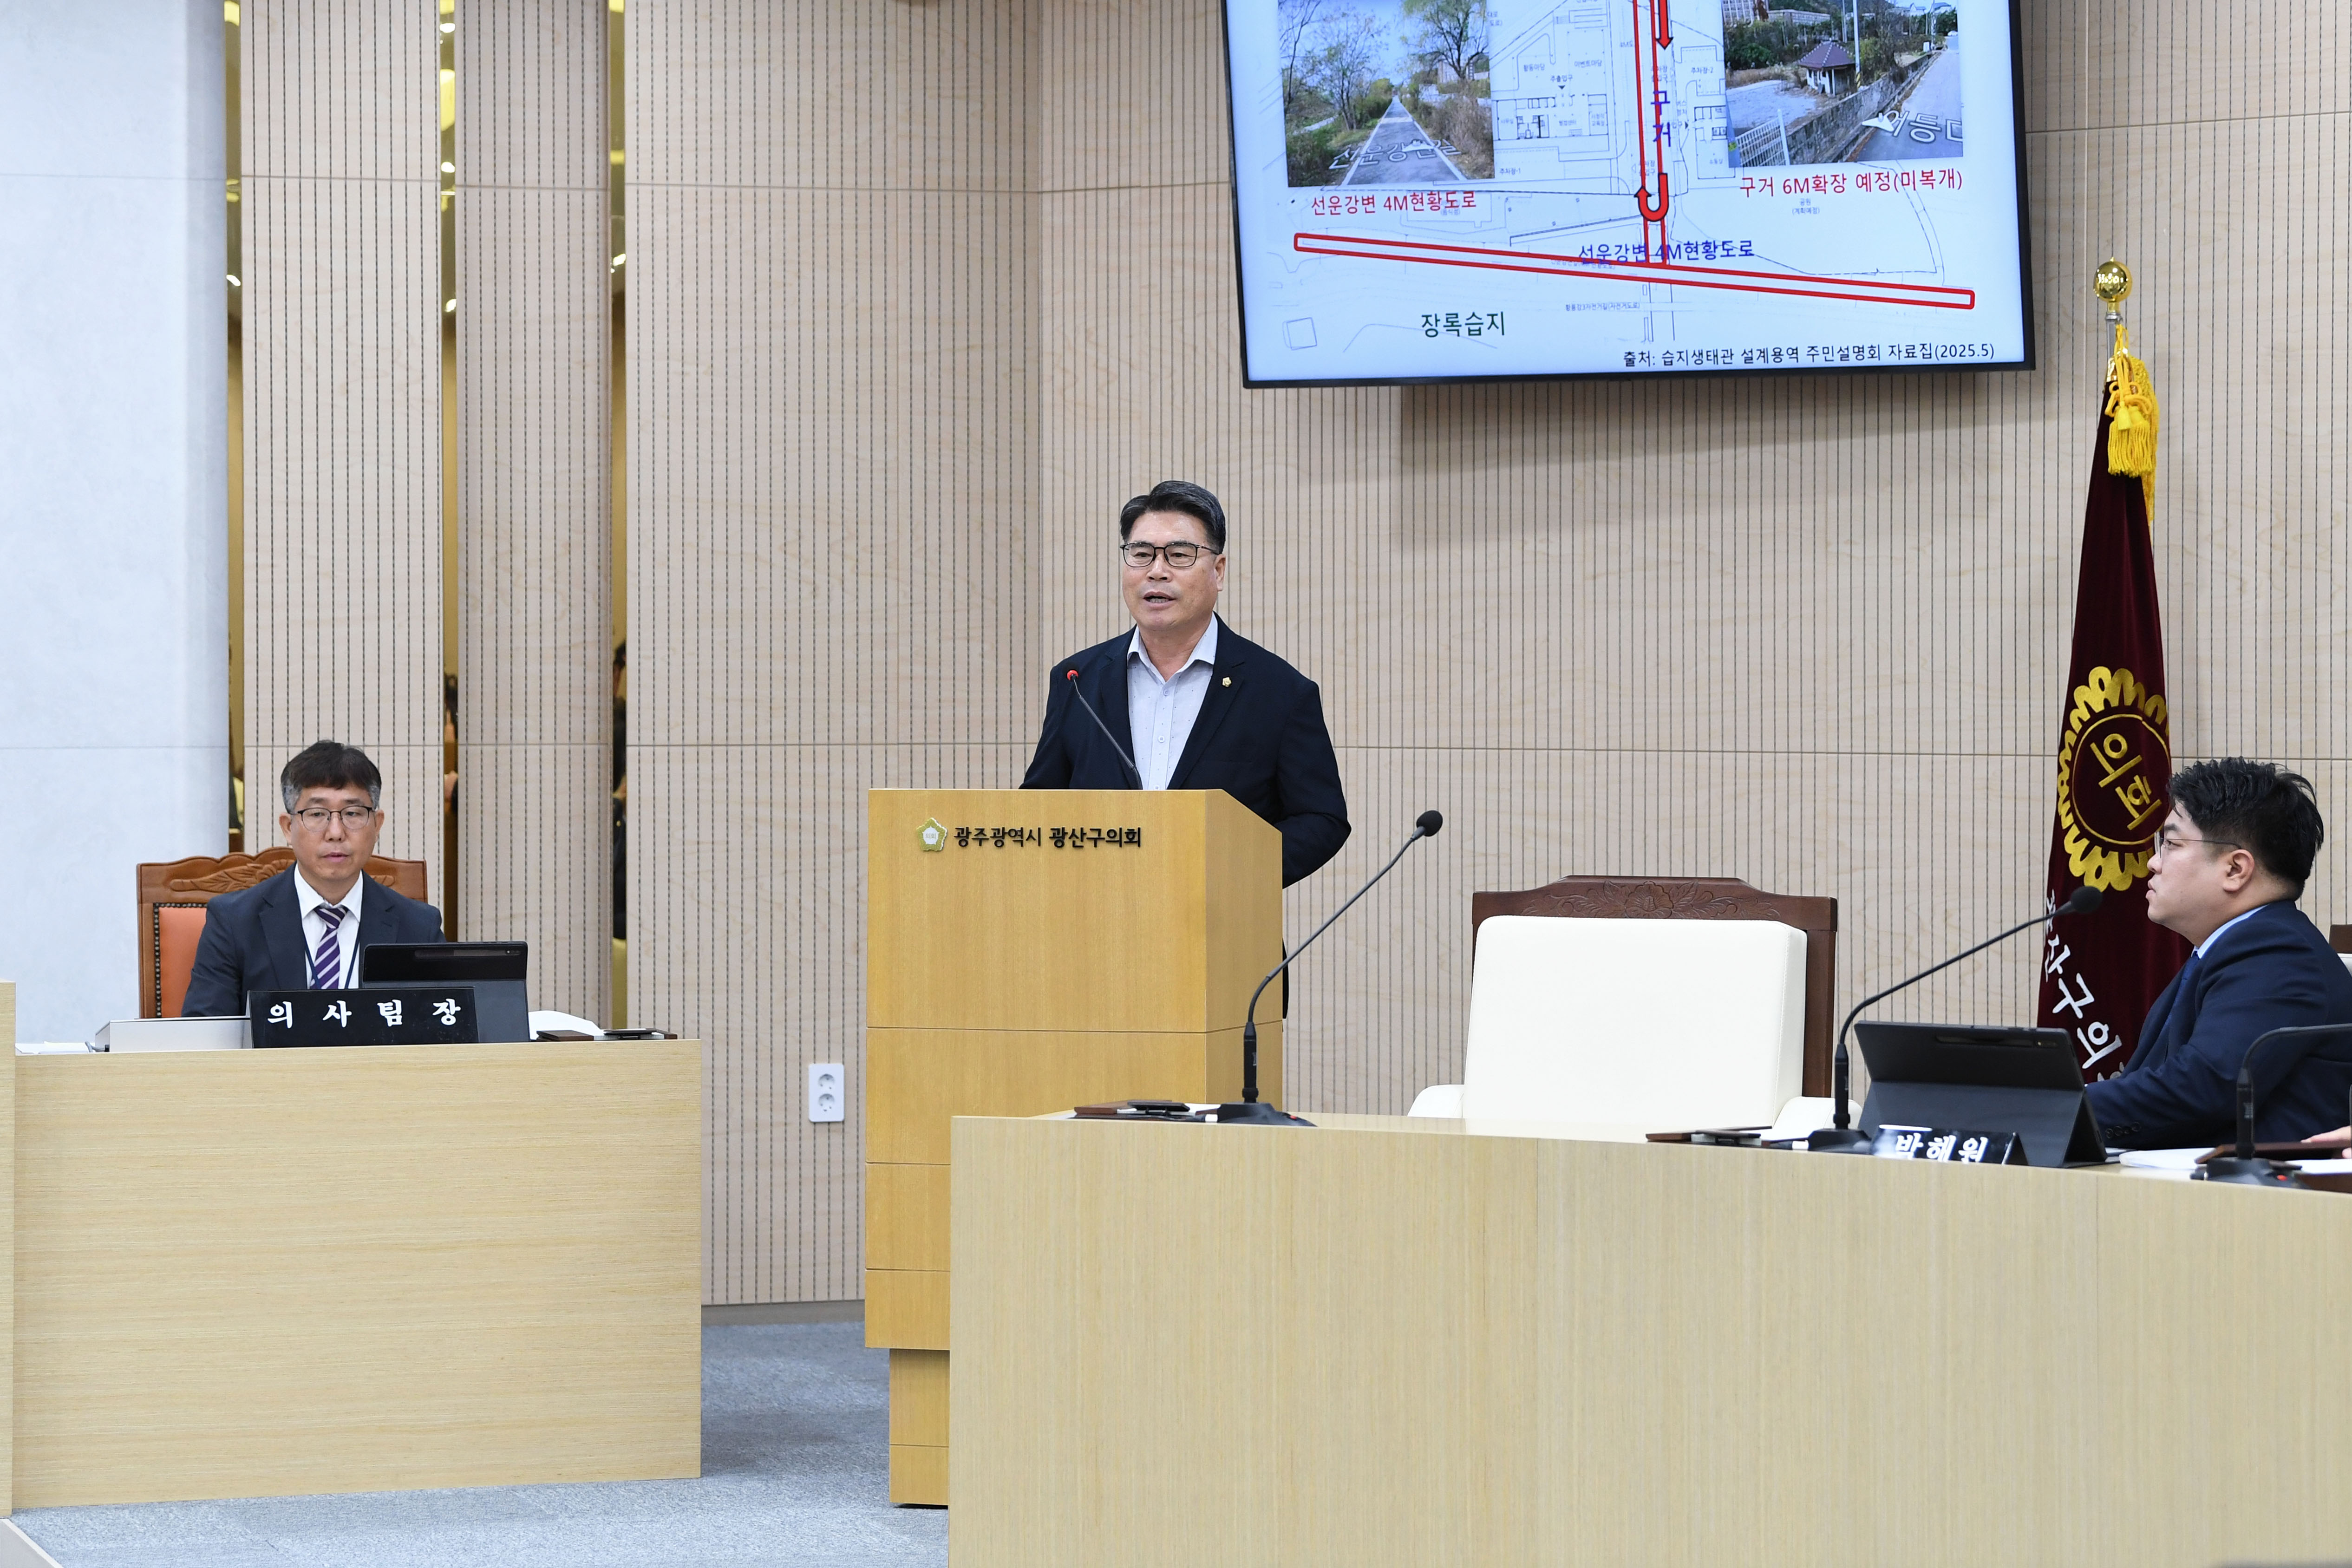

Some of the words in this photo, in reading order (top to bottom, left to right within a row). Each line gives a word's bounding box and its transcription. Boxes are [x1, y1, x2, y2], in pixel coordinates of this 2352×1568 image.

[1740, 176, 1774, 198] 구거
[1783, 174, 1847, 194] 6M확장
[1855, 169, 1963, 193] 예정(미복개)
[1312, 195, 1376, 216] 선운강변
[1384, 190, 1477, 212] 4M현황도로
[1578, 243, 1647, 265] 선운강변
[1655, 240, 1755, 261] 4M현황도로
[1422, 312, 1505, 338] 장록습지
[1623, 350, 1656, 367] 출처:
[1661, 348, 1735, 366] 습지생태관
[1741, 346, 1799, 364] 설계용역
[1806, 344, 1881, 362] 주민설명회
[1888, 343, 1995, 361] 자료집(2025.5)
[2090, 732, 2162, 830] 의회
[954, 826, 1042, 847] 광주광역시
[1049, 826, 1142, 848] 광산구의회
